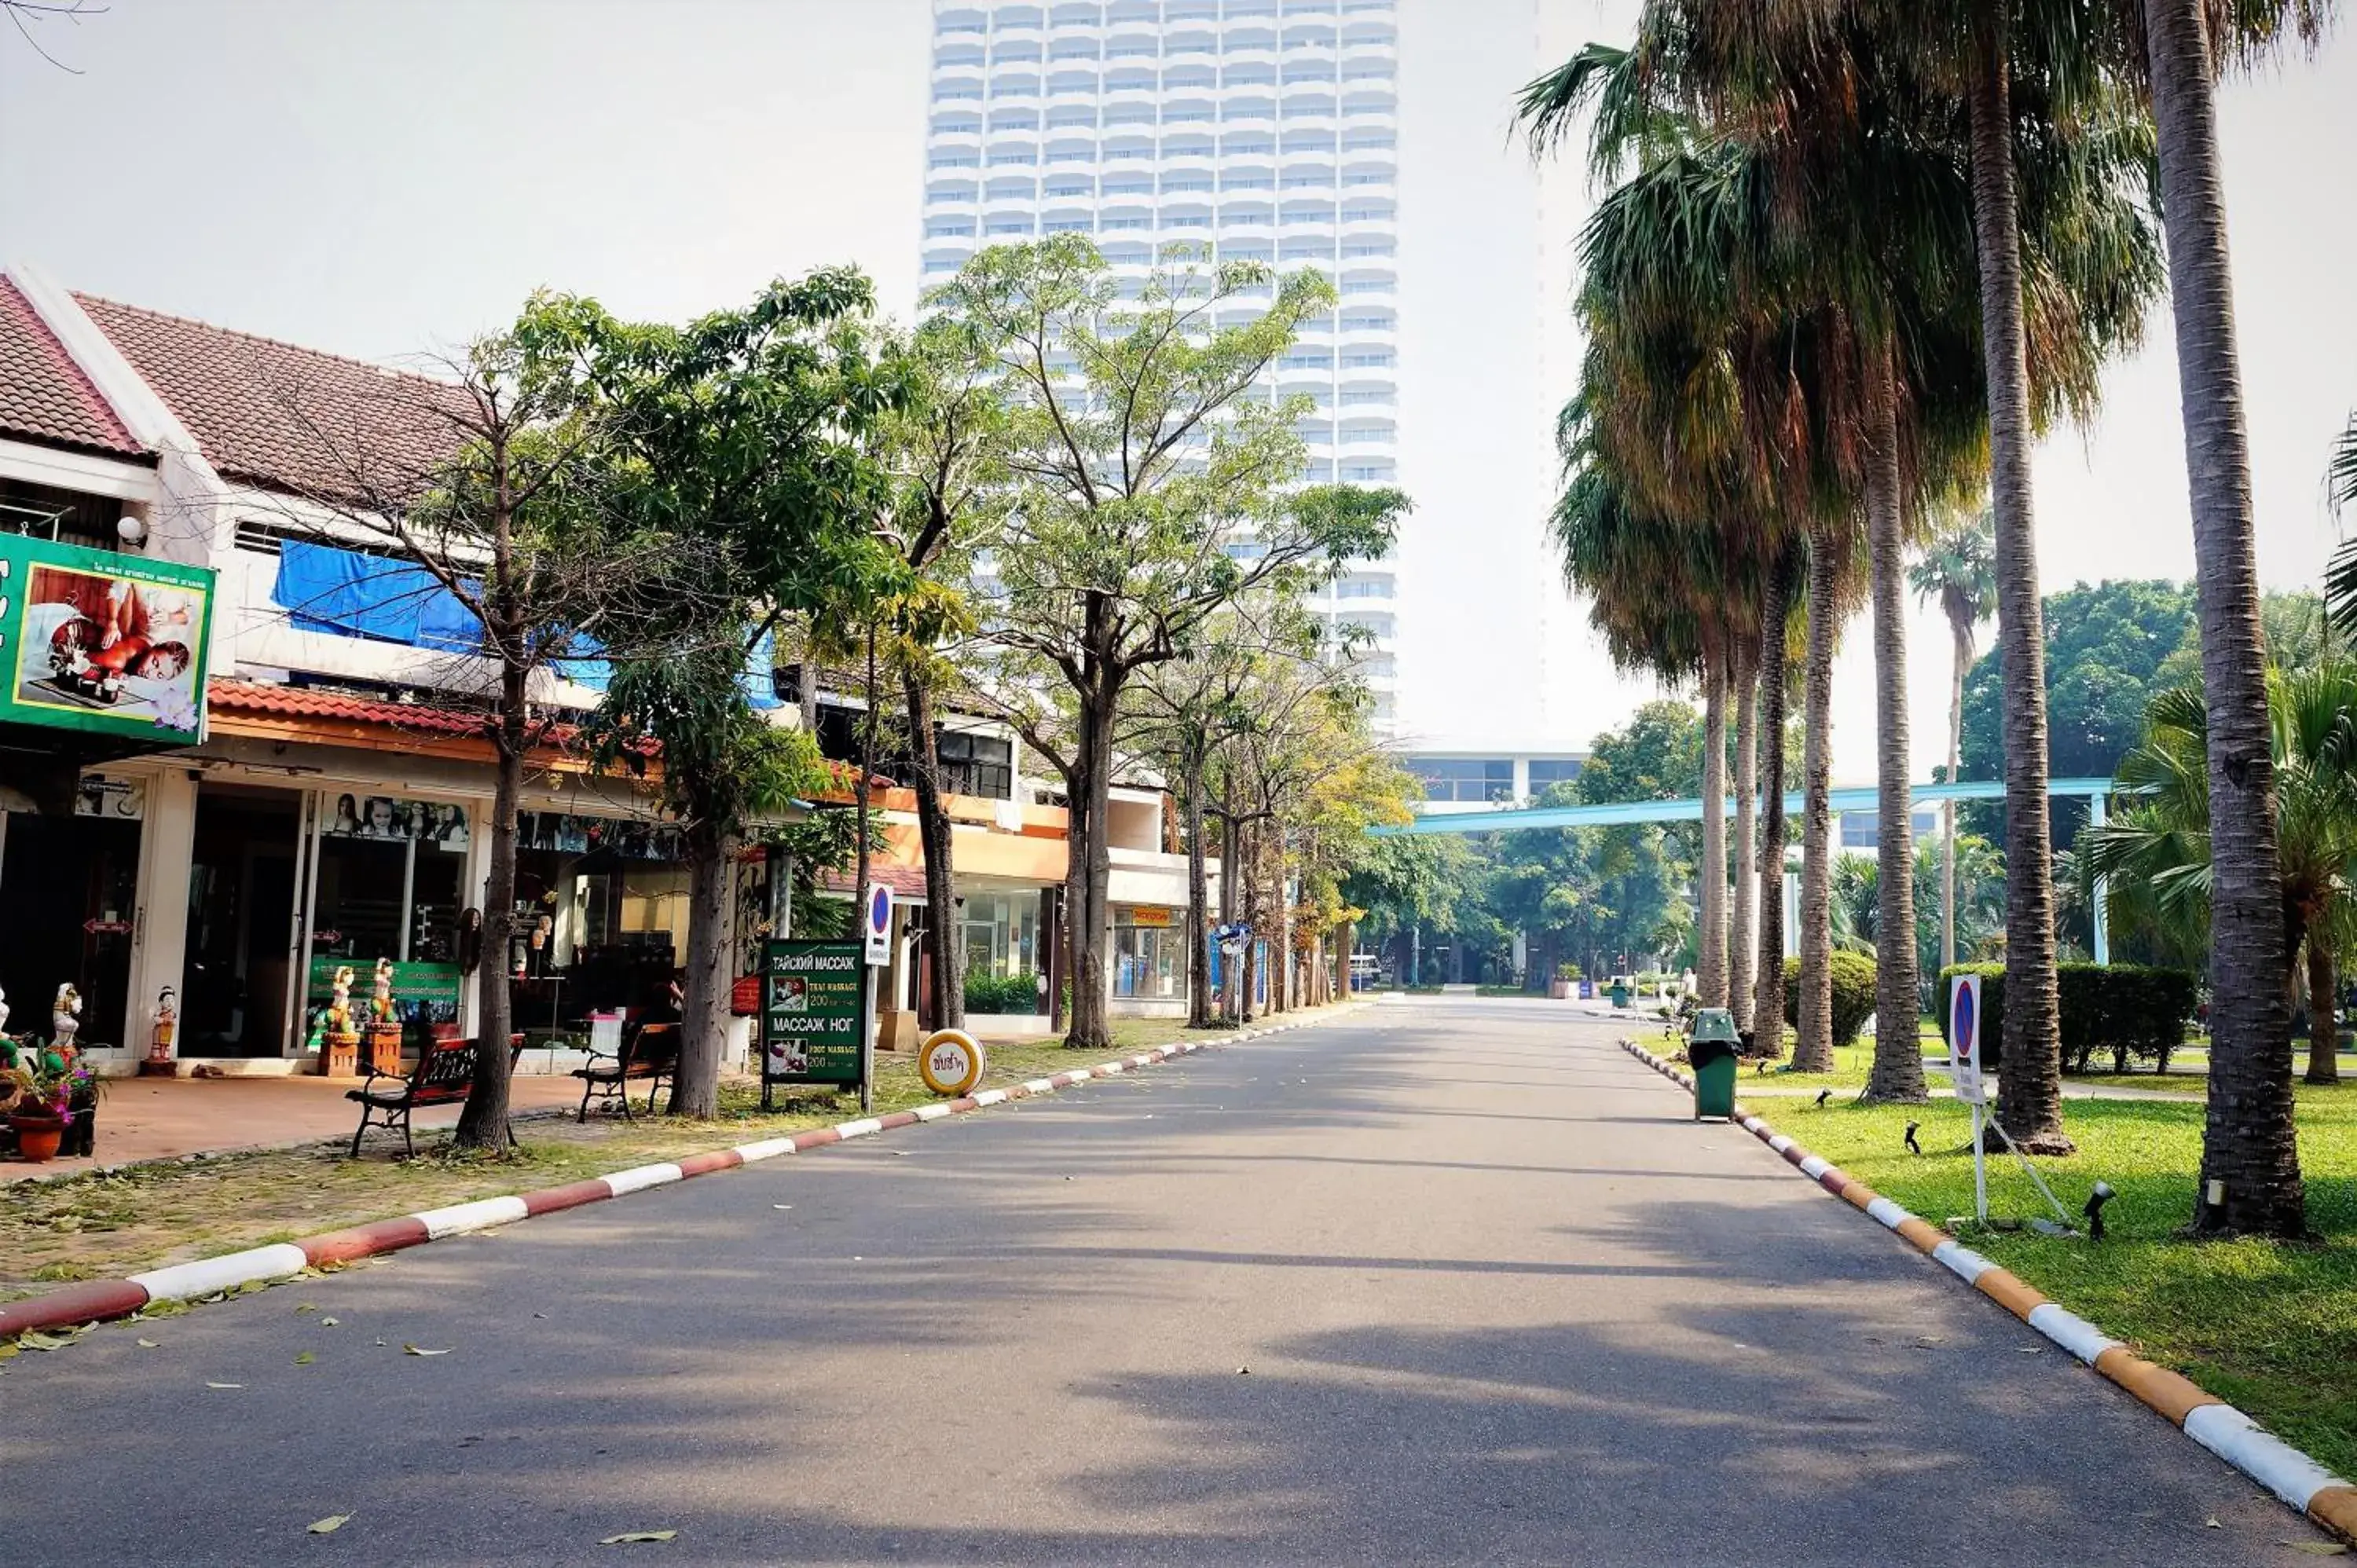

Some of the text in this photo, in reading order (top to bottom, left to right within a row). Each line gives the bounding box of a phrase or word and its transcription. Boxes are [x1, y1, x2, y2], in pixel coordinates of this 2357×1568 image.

[773, 954, 856, 970] ТАЙСКИЙ МАССАЖ
[810, 994, 828, 1006] 200
[774, 1017, 854, 1031] МАССАЖ НОГ
